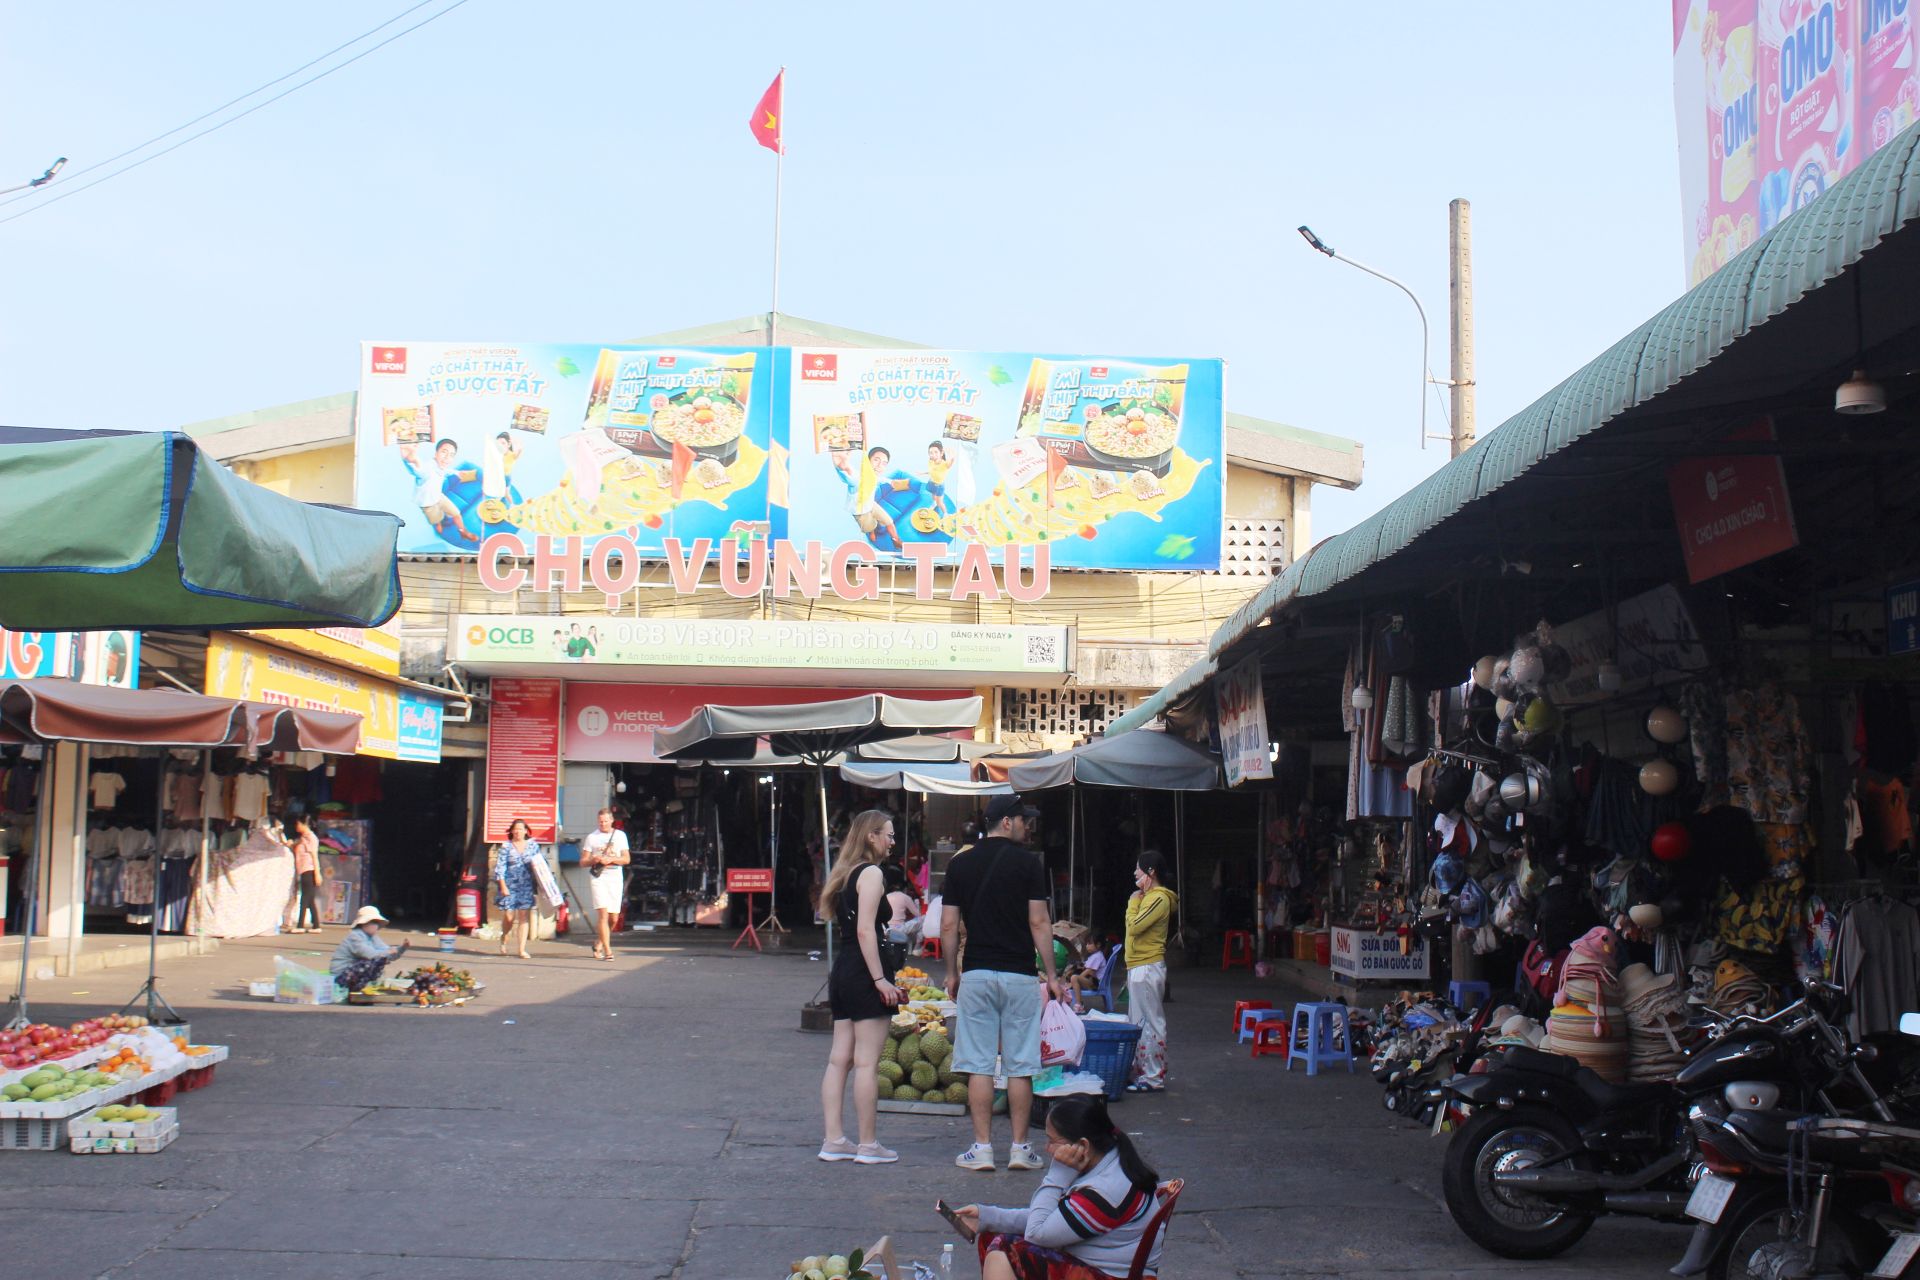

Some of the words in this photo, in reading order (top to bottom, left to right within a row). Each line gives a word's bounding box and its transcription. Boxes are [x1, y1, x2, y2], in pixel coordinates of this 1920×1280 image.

[1780, 2, 1833, 104] OMO
[375, 363, 404, 371] VIFON
[806, 370, 834, 378] VIFON
[915, 367, 957, 383] THẬT
[446, 376, 499, 395] ĐƯỢC
[504, 368, 545, 395] TẤT
[1055, 369, 1080, 389] MÌ
[877, 384, 931, 403] ĐƯỢC
[937, 380, 978, 404] TẤT
[1082, 385, 1115, 401] THỊT
[1713, 518, 1726, 537] 4.0
[1726, 512, 1742, 533] XIN
[477, 526, 641, 616] CHỢ
[663, 519, 880, 601] VŨNG
[900, 525, 1051, 601] TÀU
[1891, 590, 1917, 621] KHU
[488, 627, 534, 645] OCB
[616, 623, 665, 647] OCB
[672, 623, 754, 649] VietQR
[776, 625, 843, 649] Phiên
[850, 627, 895, 655] chợ
[900, 629, 939, 651] 4.0
[985, 632, 1007, 640] NGAY
[613, 709, 665, 722] viettel
[1336, 931, 1351, 954] SANG
[1361, 935, 1380, 952] SỬA
